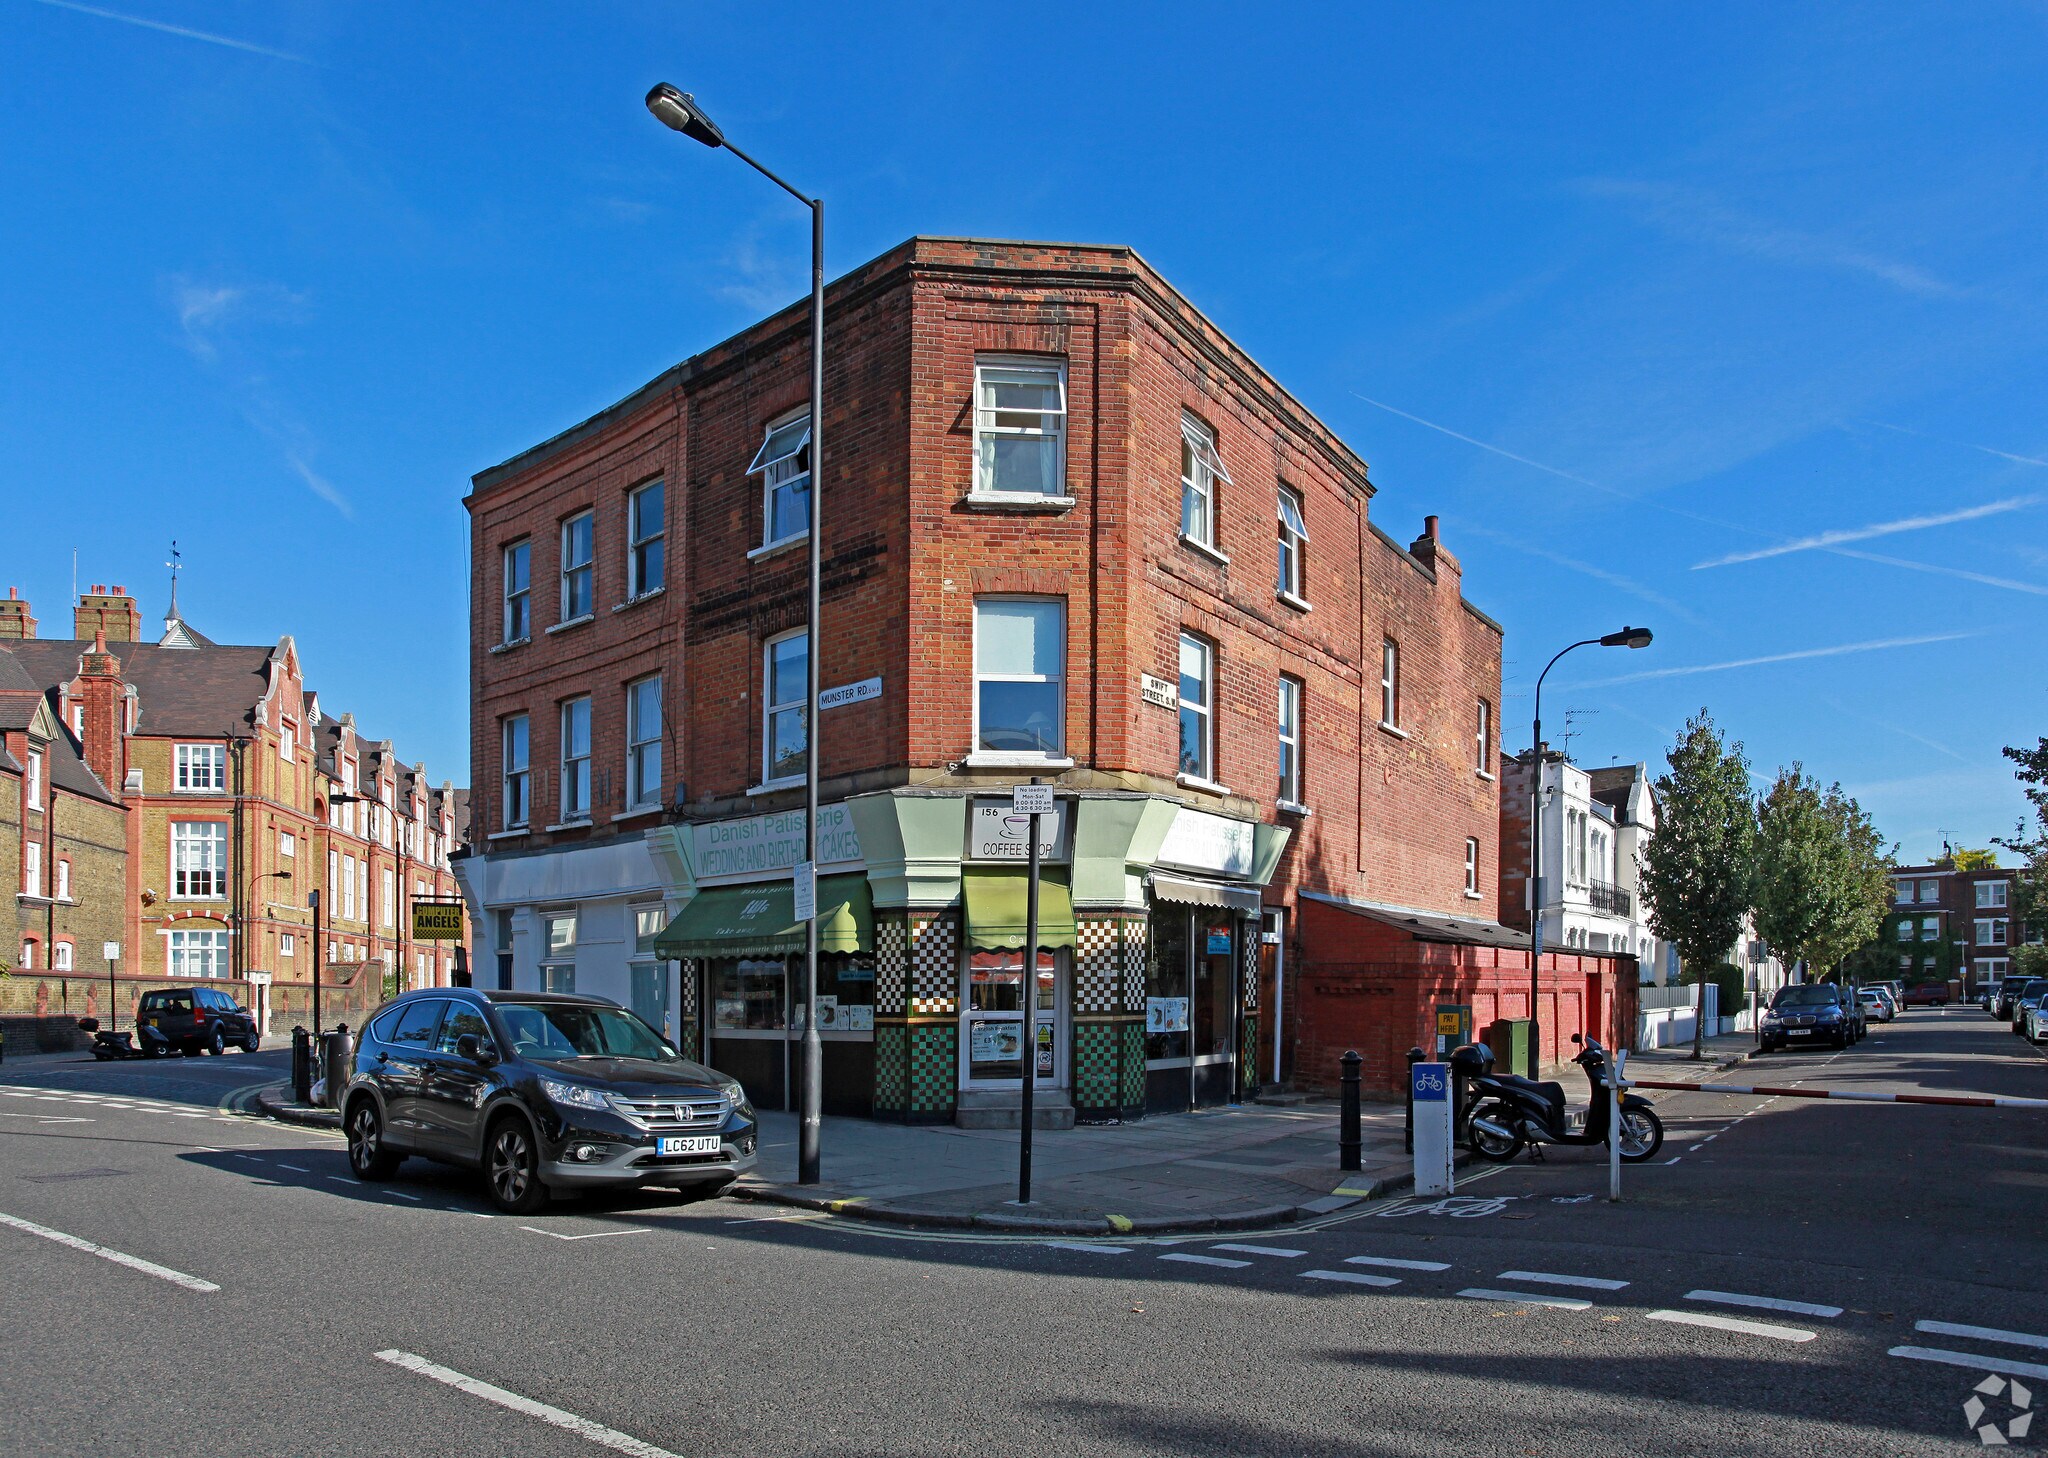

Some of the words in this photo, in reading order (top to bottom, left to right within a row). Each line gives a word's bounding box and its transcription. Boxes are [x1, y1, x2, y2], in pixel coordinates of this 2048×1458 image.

[1150, 679, 1168, 693] SWIFT
[821, 688, 855, 705] MUNSTER
[981, 808, 999, 817] 156
[710, 819, 760, 844] Danish
[700, 847, 745, 876] WEDDING
[746, 843, 767, 871] AND
[822, 830, 861, 861] CAKES
[983, 842, 1022, 856] COFFEE
[1024, 842, 1053, 856] SOP
[416, 905, 460, 916] COMPUTER
[417, 915, 460, 928] ANGELS
[1443, 1014, 1454, 1023] PAY
[1440, 1025, 1457, 1033] HERE
[665, 1139, 695, 1153] LC62
[697, 1137, 718, 1152] UTU
